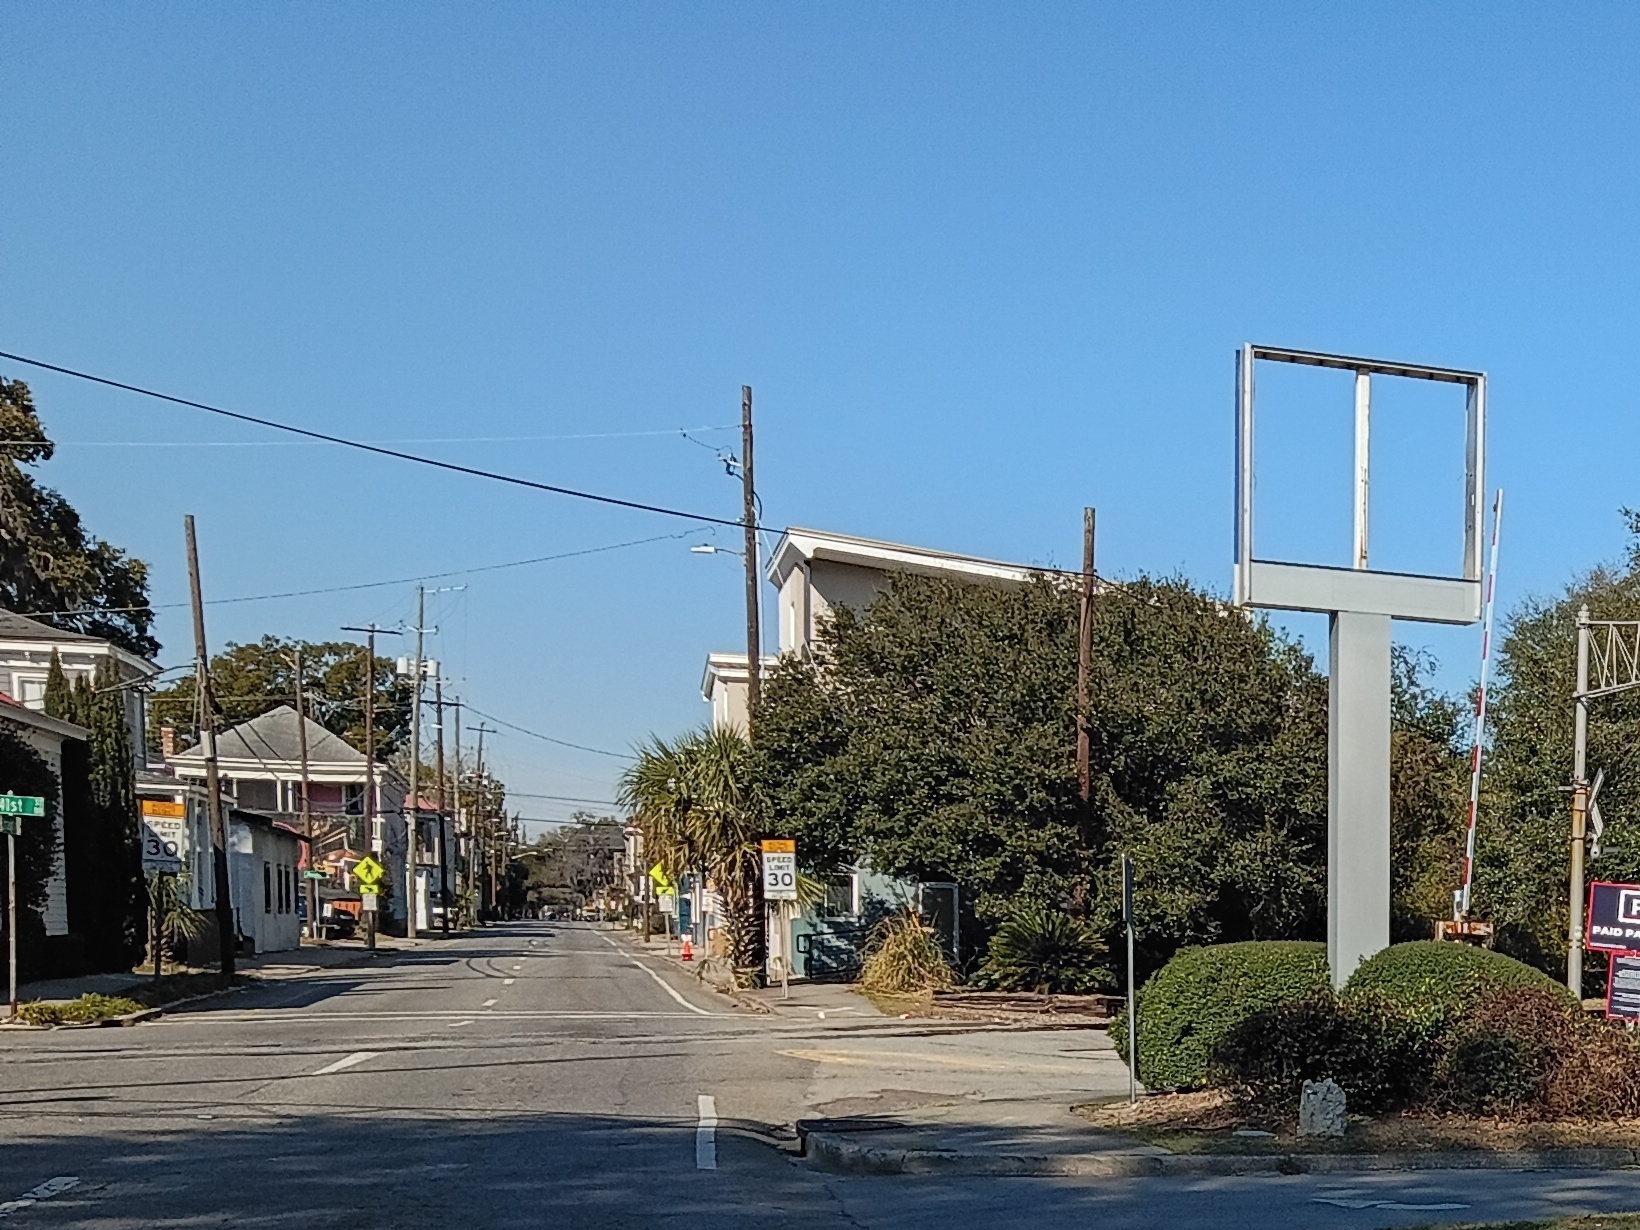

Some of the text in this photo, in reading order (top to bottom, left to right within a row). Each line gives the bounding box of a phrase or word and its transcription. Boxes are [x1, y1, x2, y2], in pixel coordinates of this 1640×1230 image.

[146, 820, 182, 829] SPEED
[146, 839, 178, 857] 30
[767, 872, 793, 886] 30
[1592, 925, 1623, 937] PAID
